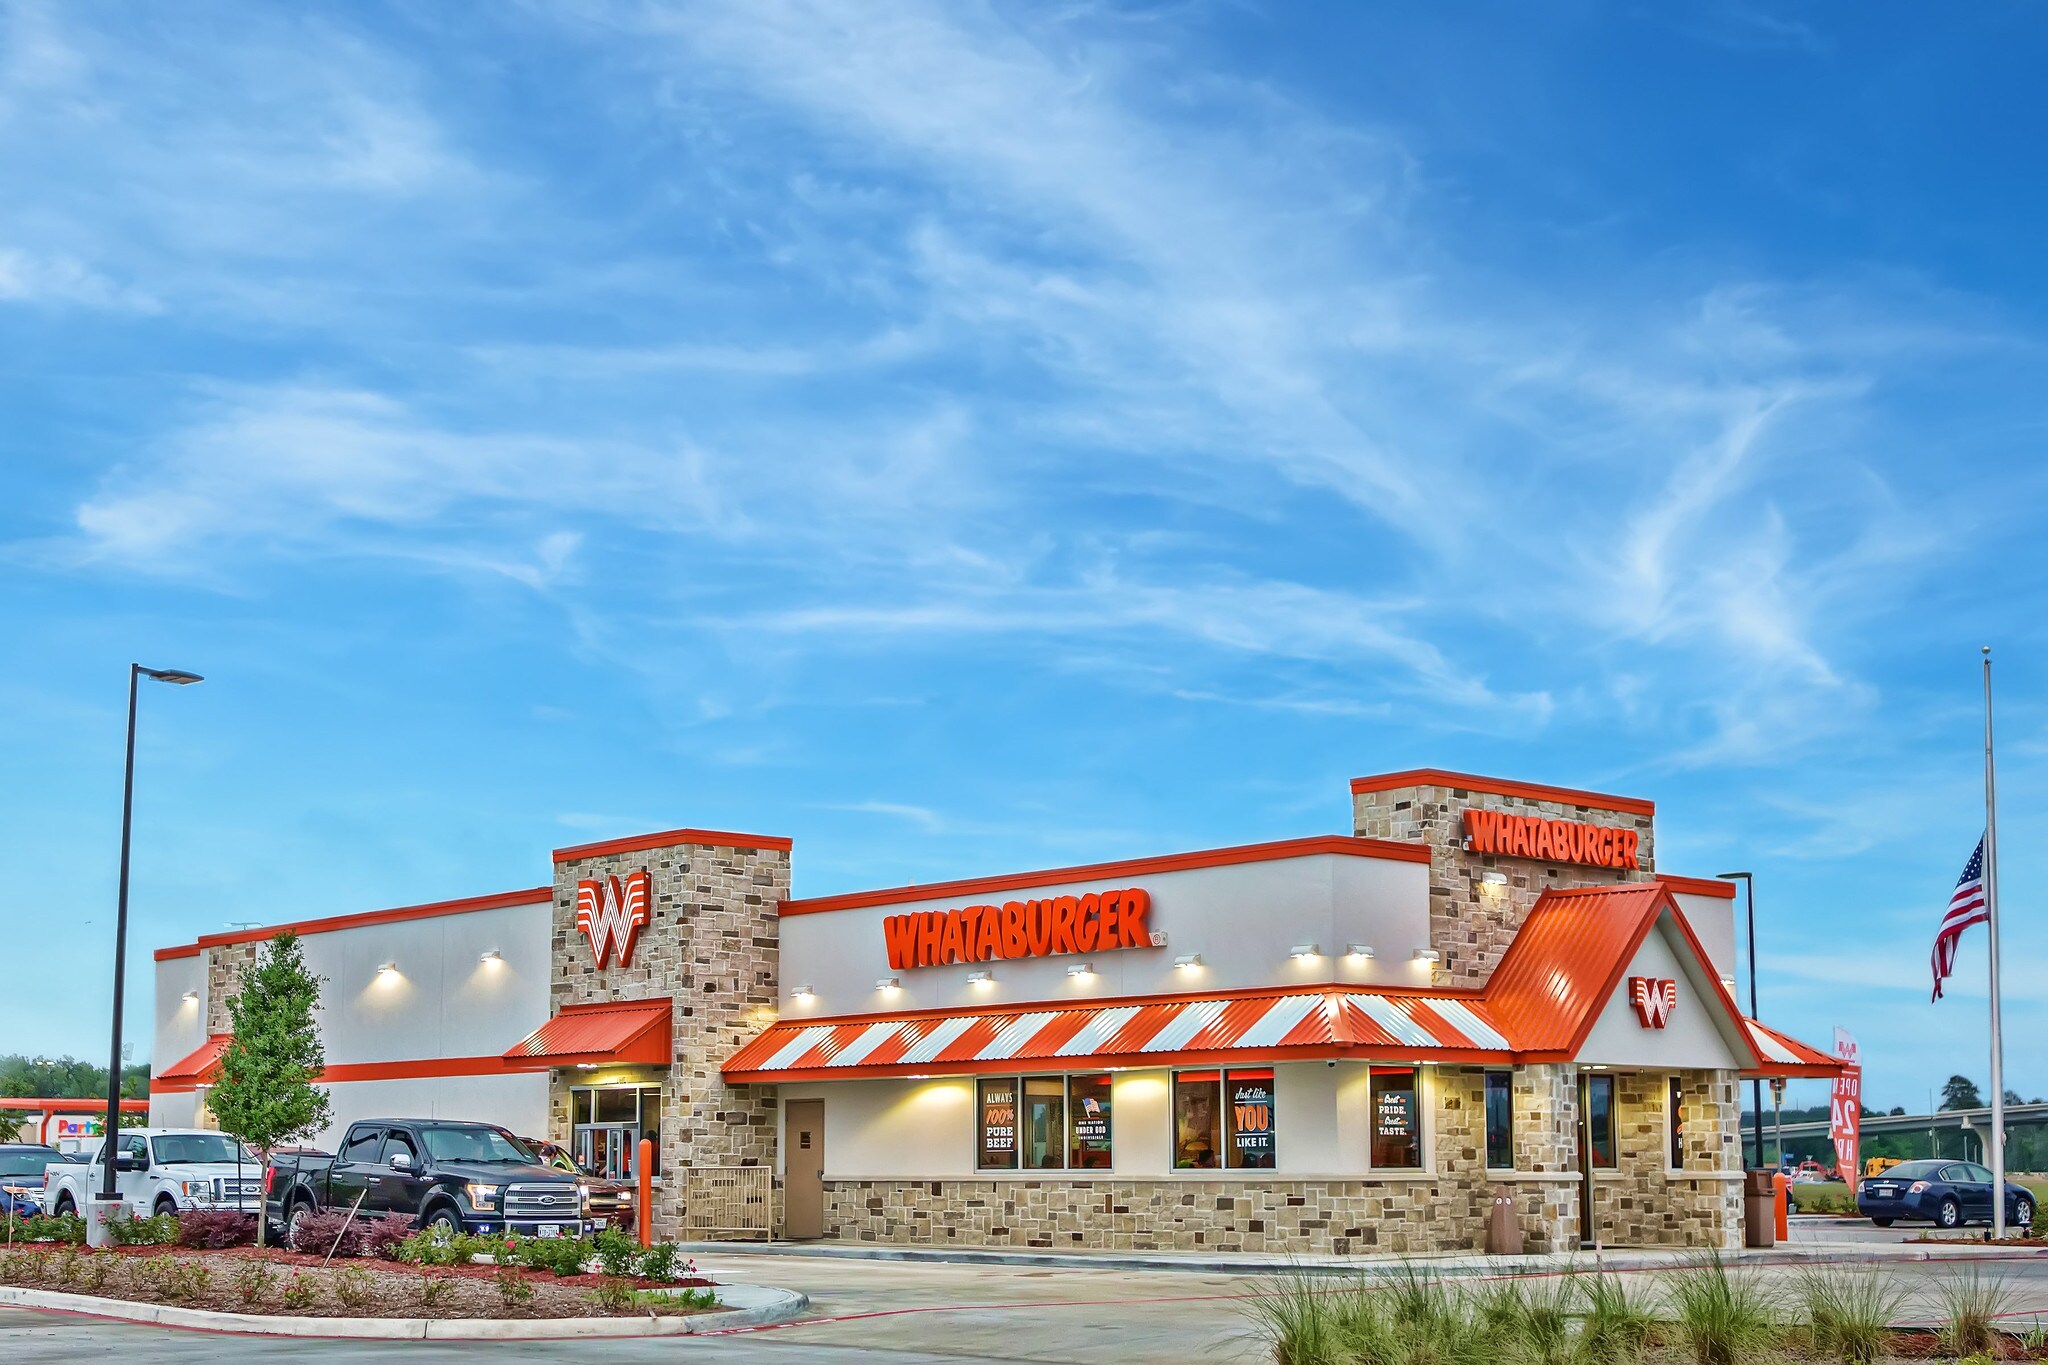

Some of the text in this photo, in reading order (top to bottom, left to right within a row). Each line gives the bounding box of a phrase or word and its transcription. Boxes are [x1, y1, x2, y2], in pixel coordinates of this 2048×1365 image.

[1463, 810, 1640, 870] WHATABURGER
[577, 871, 652, 971] W
[883, 888, 1151, 970] WHATABURGER
[986, 1092, 1013, 1104] ALWAYS
[1252, 1087, 1267, 1100] like
[1379, 1106, 1406, 1114] PRIDE.
[986, 1108, 1015, 1125] 100%
[1234, 1104, 1269, 1132] YOU
[986, 1126, 1014, 1137] PURE
[1075, 1125, 1107, 1134] UNDER GOD
[1379, 1127, 1407, 1135] TASTE.
[986, 1138, 1014, 1149] BEEF
[1236, 1137, 1269, 1148] LIKE IT.
